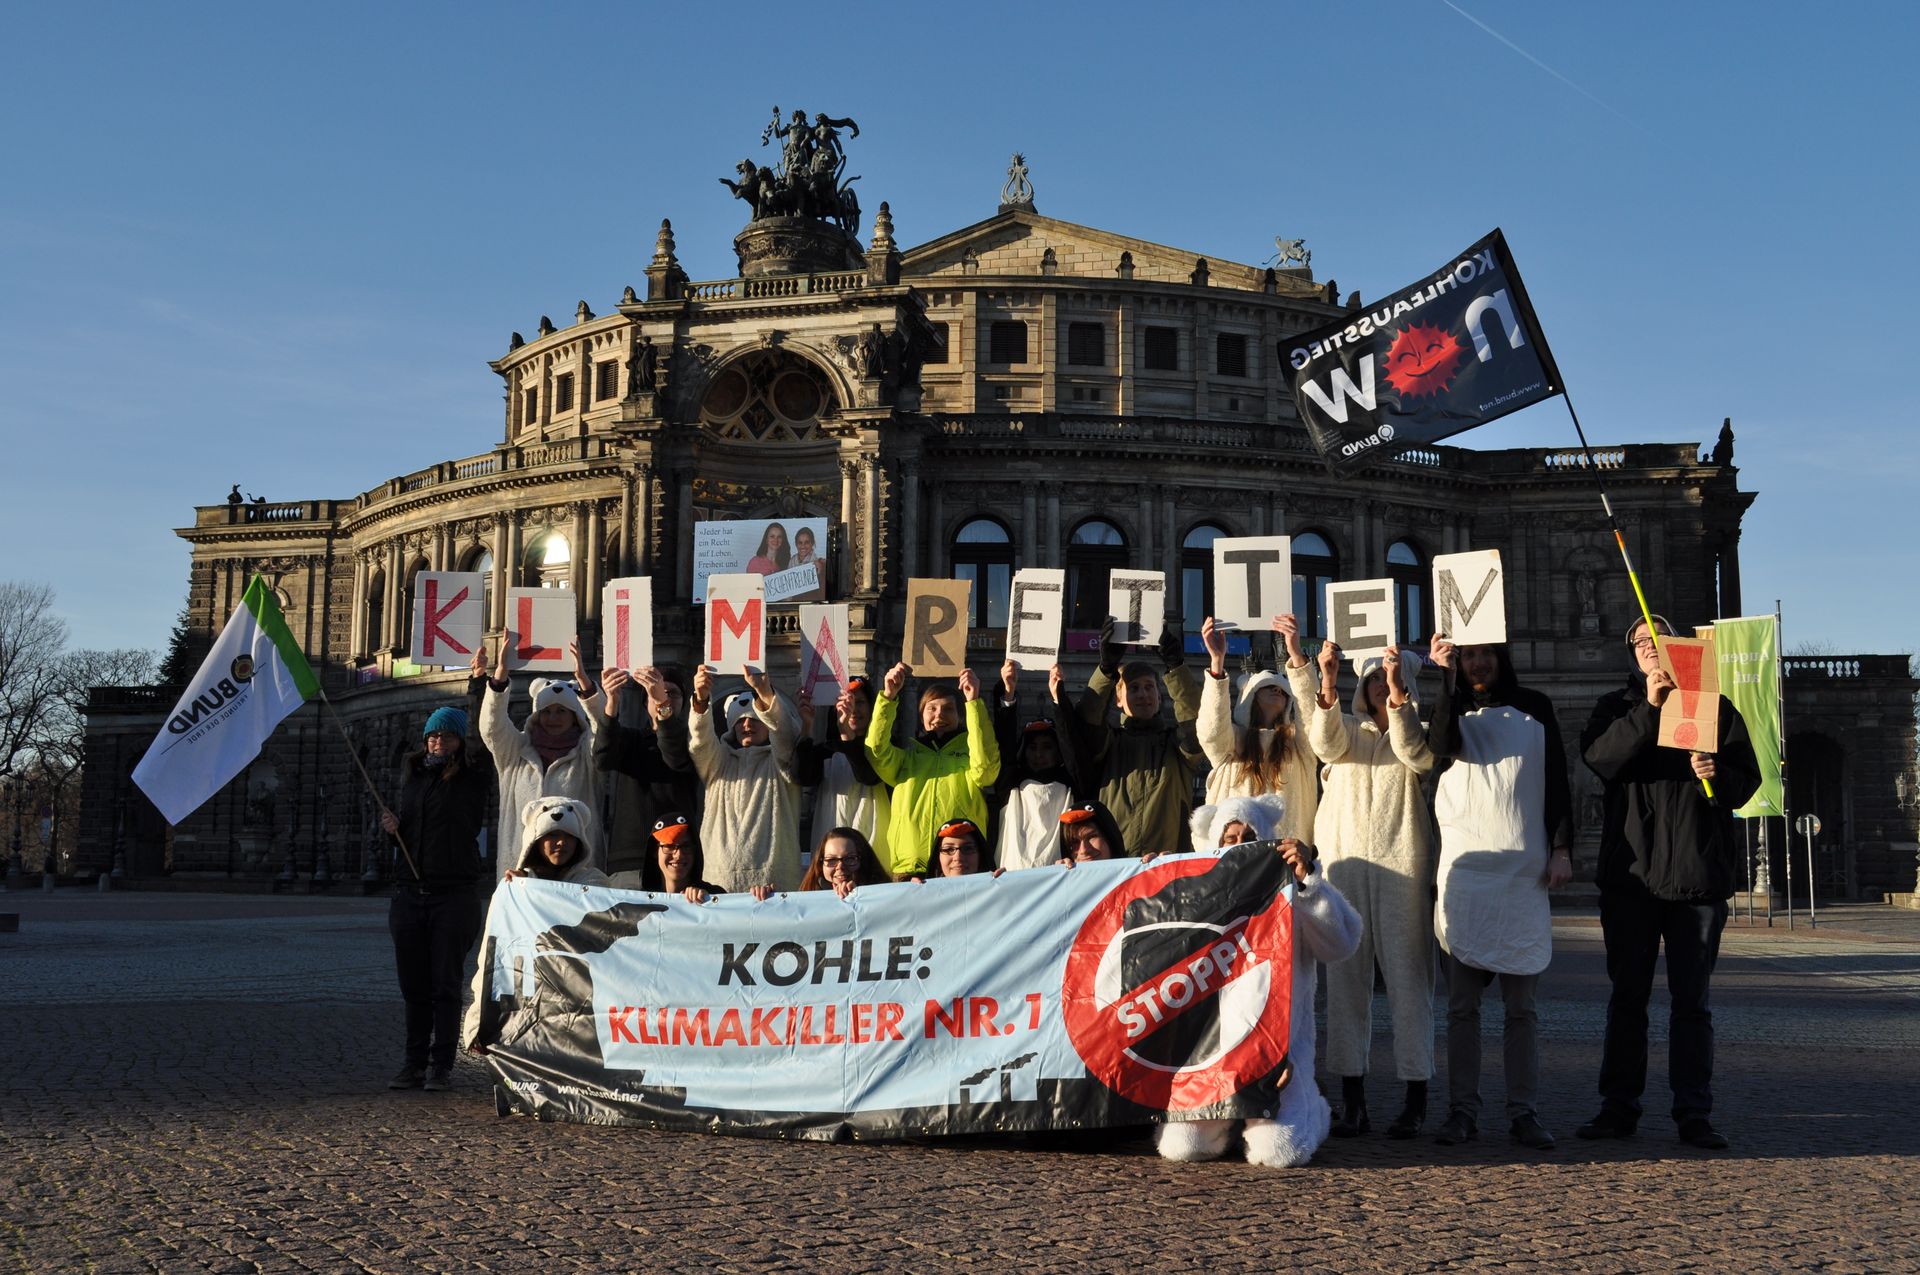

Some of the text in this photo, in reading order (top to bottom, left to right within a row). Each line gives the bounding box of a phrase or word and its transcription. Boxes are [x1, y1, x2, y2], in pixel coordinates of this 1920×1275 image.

[698, 549, 710, 557] auf
[710, 538, 730, 546] Recht
[722, 527, 733, 535] hat
[698, 559, 738, 568] Freiheit und
[764, 567, 818, 597] NSCHENFREUNDE
[1223, 549, 1280, 618] T
[422, 579, 473, 658] K
[517, 597, 563, 661] L
[710, 598, 760, 662] M
[911, 594, 957, 666] R
[968, 633, 996, 648] Für
[1012, 582, 1061, 656] E
[1112, 577, 1163, 642] T
[1333, 588, 1389, 651] E
[802, 615, 848, 697] A
[718, 934, 932, 988] KOHLE:
[1115, 930, 1260, 1039] STOPP!
[608, 1002, 907, 1048] KLIMAKILLER
[511, 1081, 540, 1091] BUND
